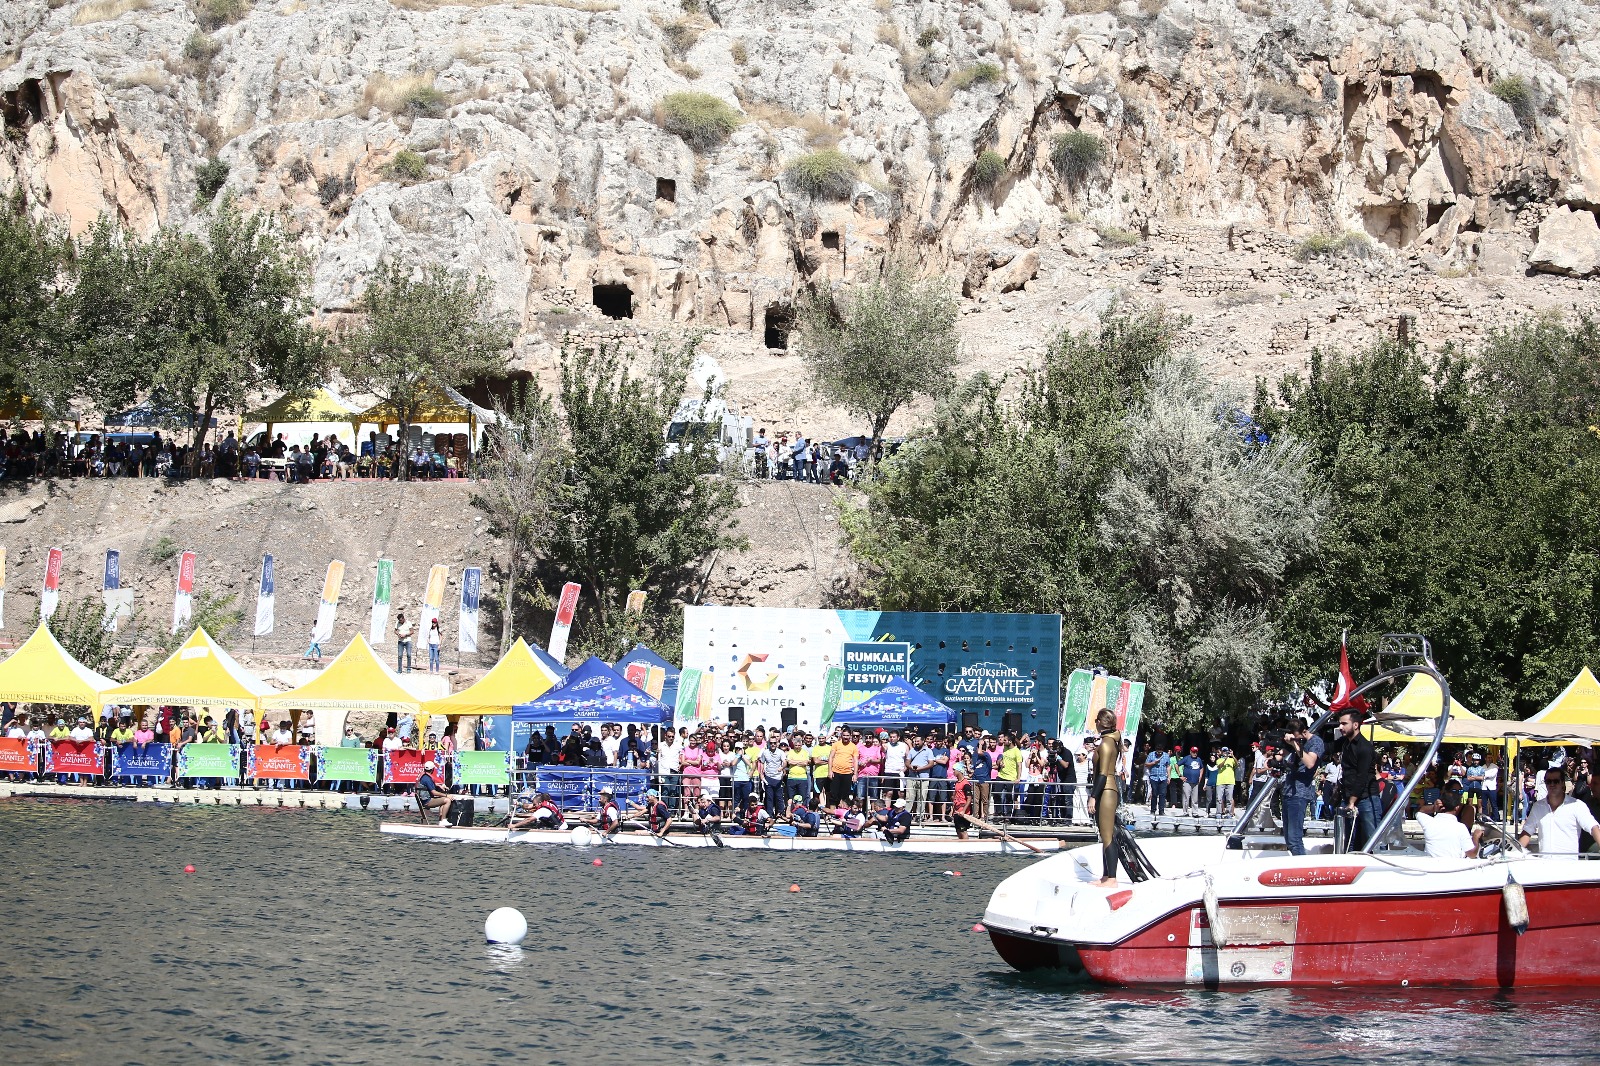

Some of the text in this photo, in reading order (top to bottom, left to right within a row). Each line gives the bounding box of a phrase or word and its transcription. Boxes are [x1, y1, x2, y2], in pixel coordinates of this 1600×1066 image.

[846, 652, 905, 662] RUMKALE
[861, 664, 905, 672] SPORLARI
[961, 667, 1018, 678] BÜYÜKŞEHİR
[847, 674, 905, 684] FESTİVA
